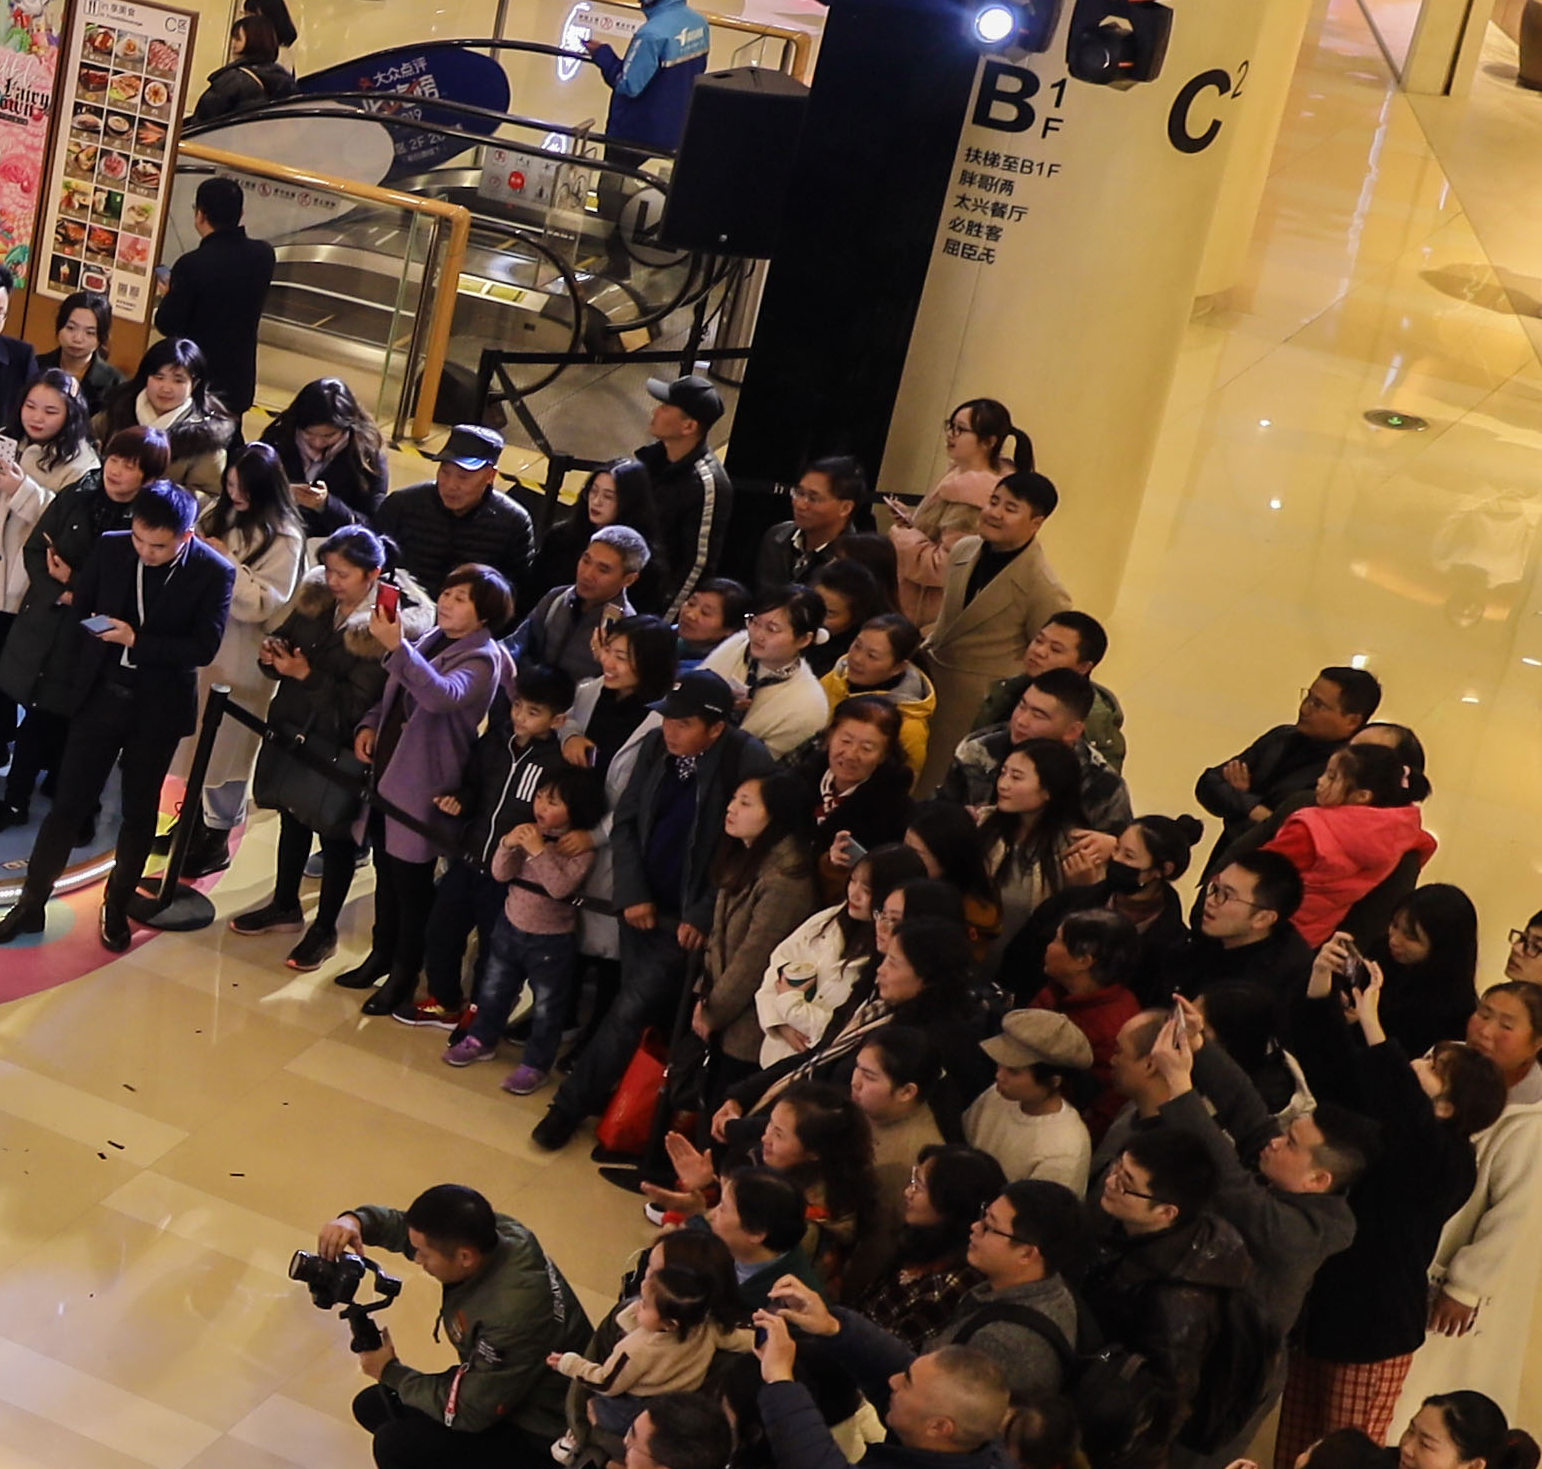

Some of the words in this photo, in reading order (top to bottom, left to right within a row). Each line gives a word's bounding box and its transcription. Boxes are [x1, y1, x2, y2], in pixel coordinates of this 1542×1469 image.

[373, 56, 429, 88] 大众点评
[964, 146, 1062, 179] 扶梯至B1F
[958, 169, 1015, 197] 胖哥俩
[953, 193, 1029, 223] 太兴餐厅
[948, 216, 1004, 243] 必胜客
